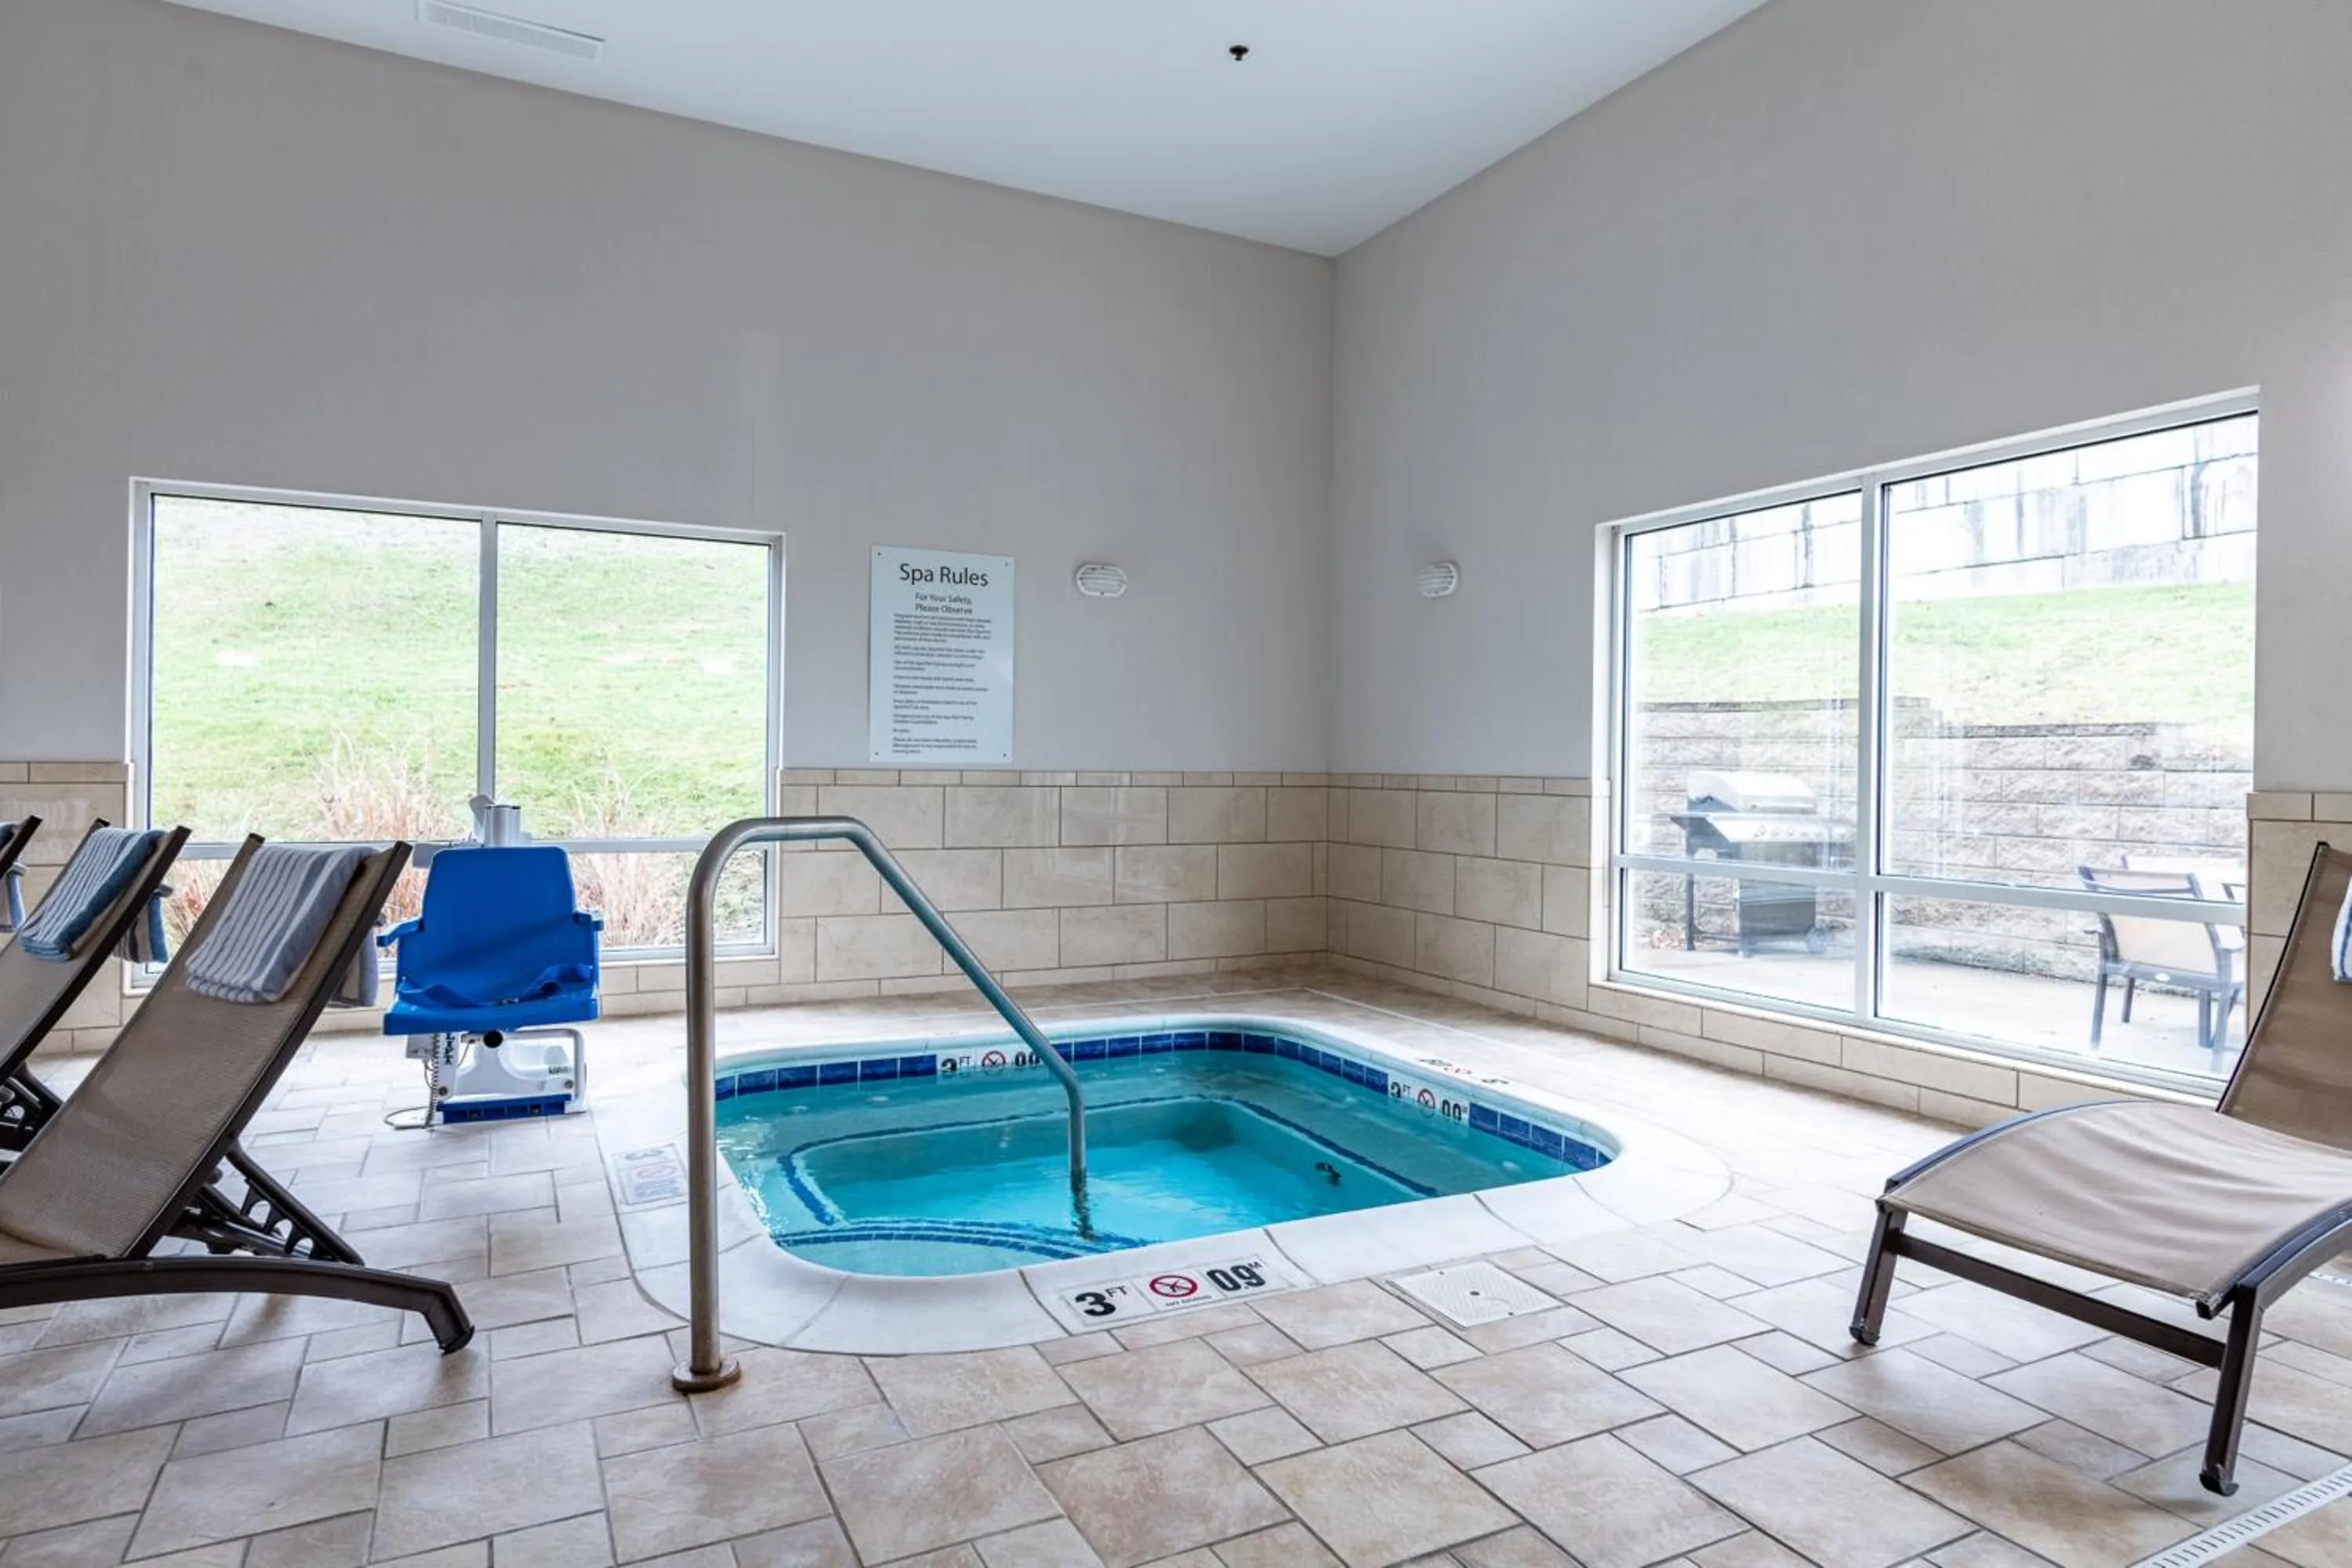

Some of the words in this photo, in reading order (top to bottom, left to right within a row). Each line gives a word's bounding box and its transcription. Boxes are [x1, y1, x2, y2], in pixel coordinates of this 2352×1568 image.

[899, 563, 934, 585] Spa
[940, 565, 989, 586] Rules
[915, 592, 927, 601] For
[929, 593, 946, 603] Your
[915, 603, 939, 612] Please
[941, 604, 973, 615] Observe
